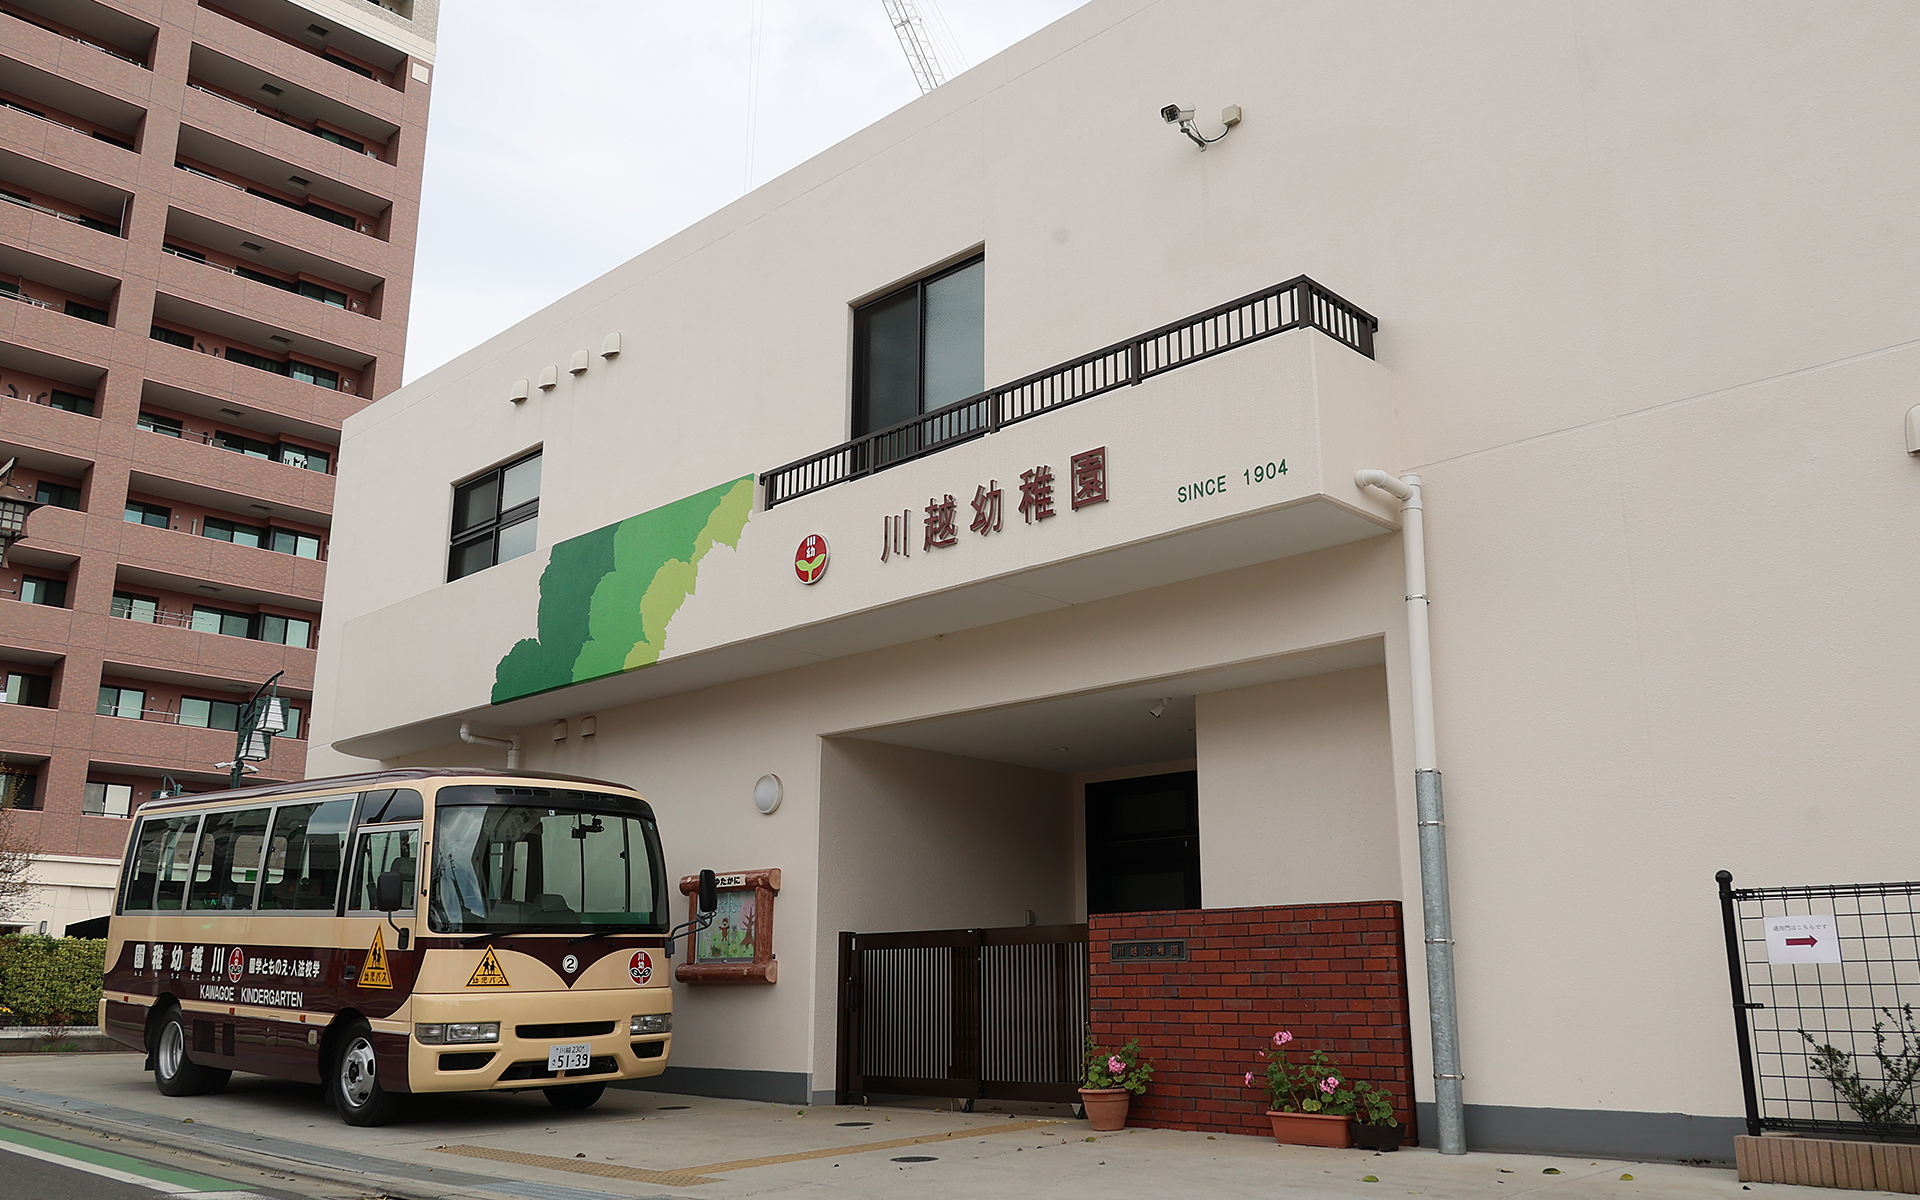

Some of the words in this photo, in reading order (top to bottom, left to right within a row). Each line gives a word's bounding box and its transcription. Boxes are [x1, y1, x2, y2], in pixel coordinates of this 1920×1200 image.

[1178, 475, 1227, 503] SINCE
[1243, 458, 1289, 486] 1904
[880, 445, 1109, 563] 川越幼稚園
[1116, 945, 1179, 957] 川越幼稚園
[566, 958, 575, 969] 2
[364, 971, 387, 982] 幼児バス
[472, 976, 504, 984] 幼児バス
[199, 984, 235, 1002] KAWAGOE
[240, 987, 304, 1008] KINDERGARTEN
[557, 1053, 588, 1068] 51-39
